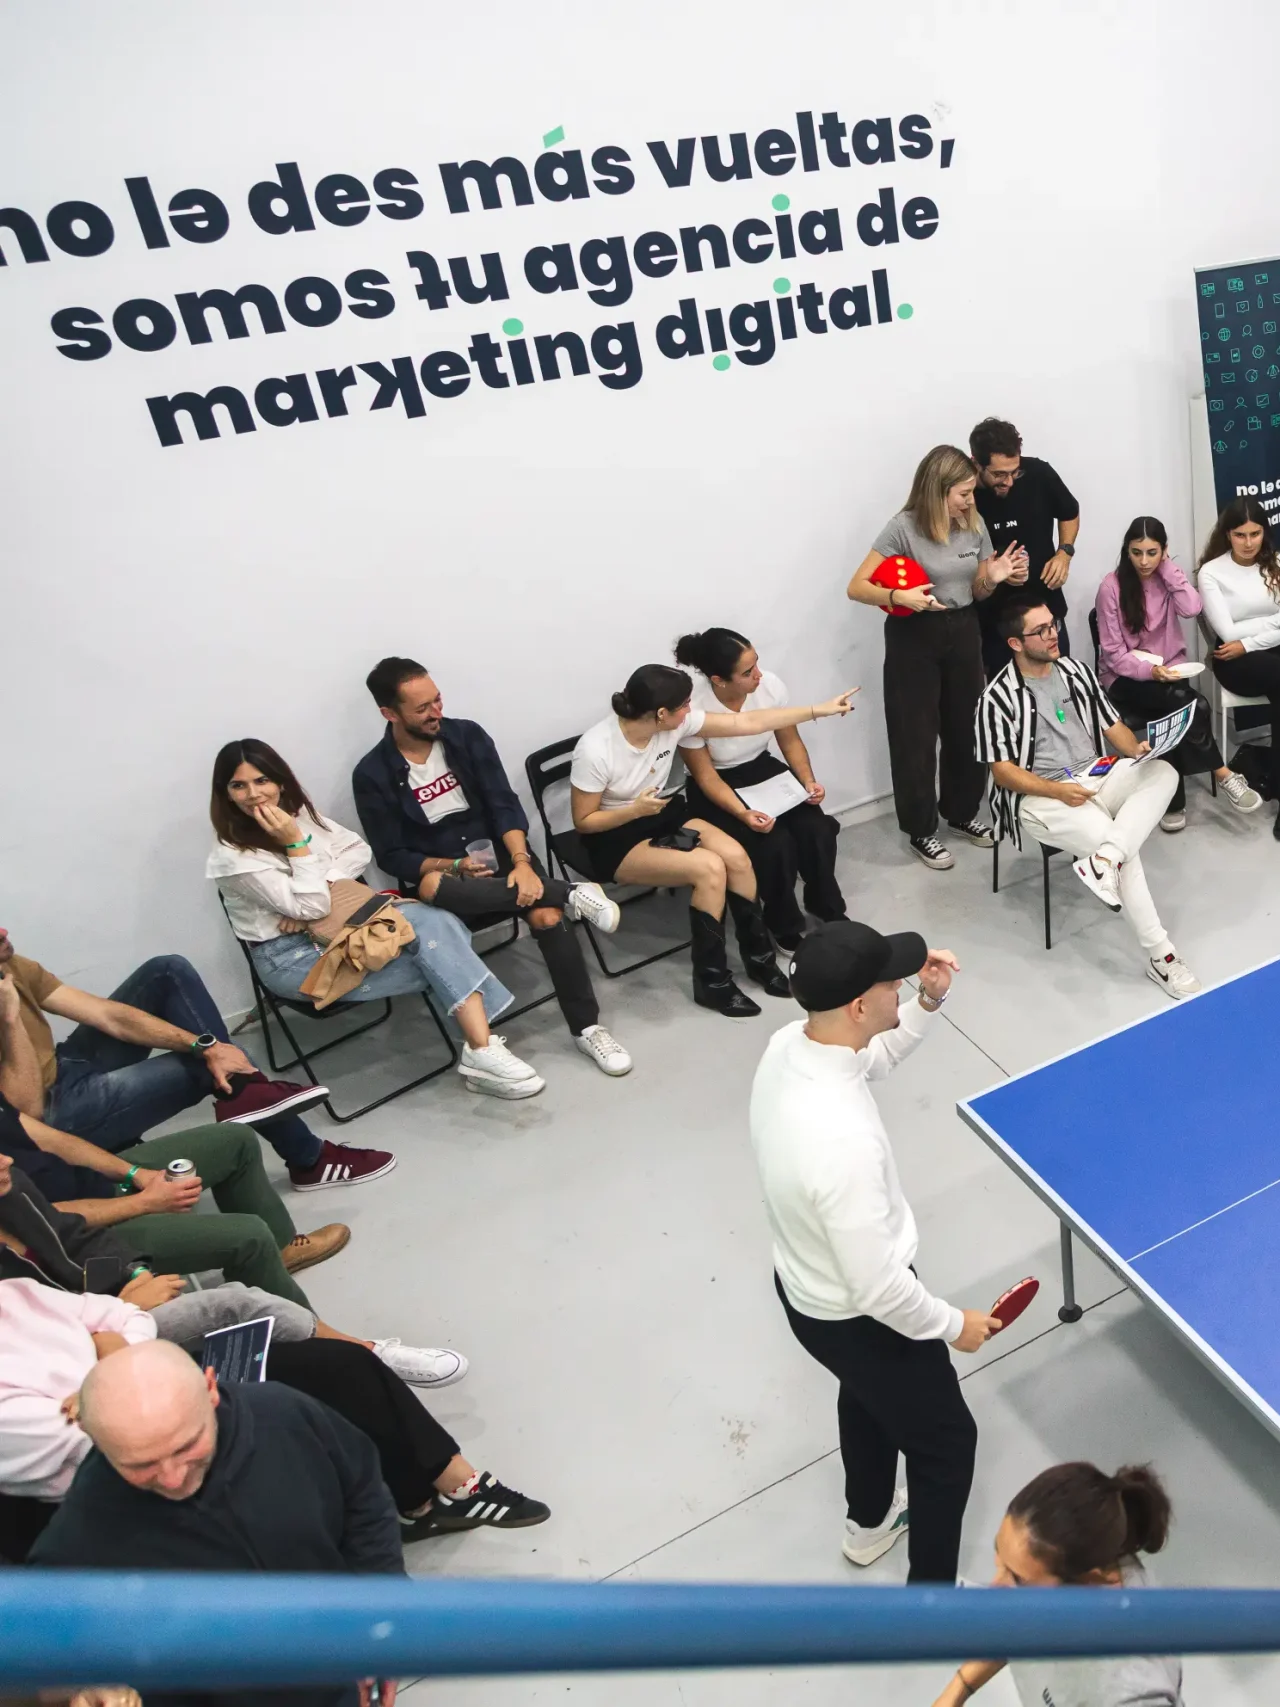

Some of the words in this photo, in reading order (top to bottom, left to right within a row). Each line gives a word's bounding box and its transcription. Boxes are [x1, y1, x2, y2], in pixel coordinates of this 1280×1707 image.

[247, 161, 425, 236] des
[438, 125, 636, 215] más
[645, 110, 955, 189] vueltas,
[50, 268, 396, 362] somos
[523, 193, 844, 308] agencia
[856, 186, 939, 247] de
[655, 268, 914, 371] digital.
[1236, 483, 1259, 497] no
